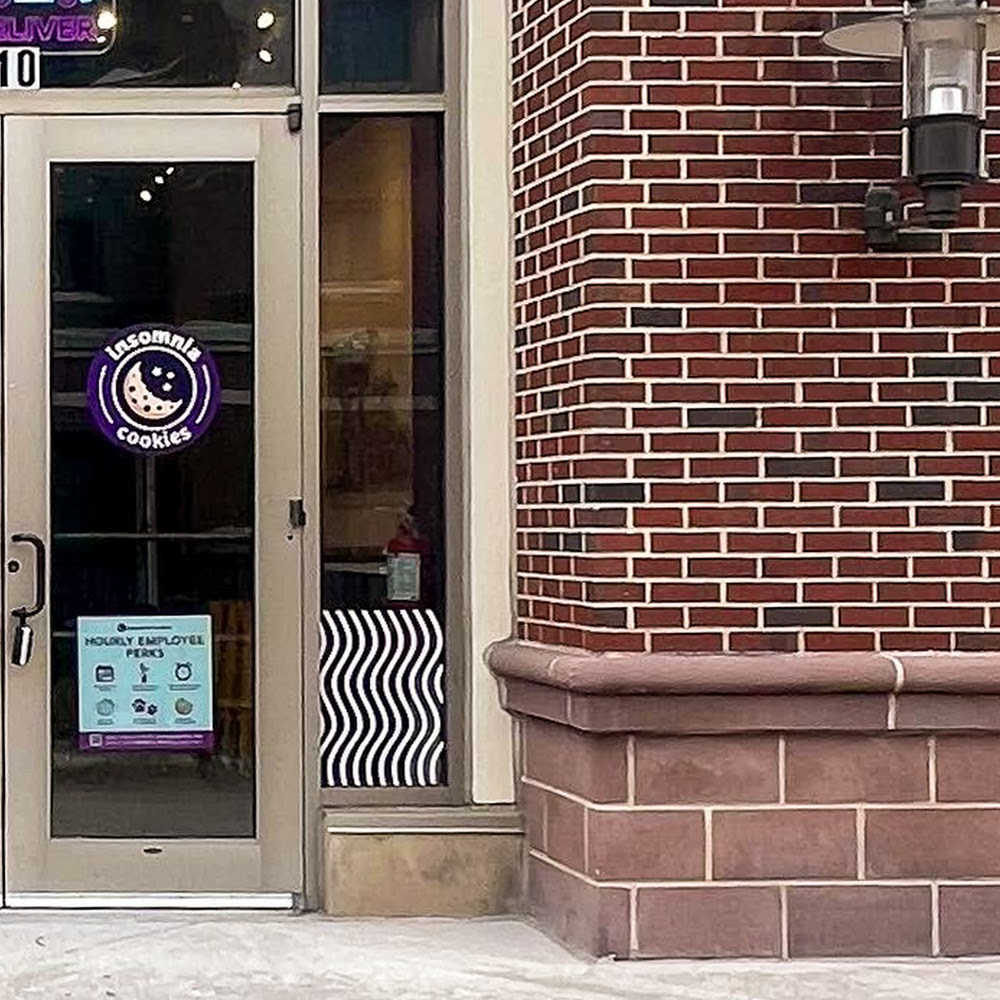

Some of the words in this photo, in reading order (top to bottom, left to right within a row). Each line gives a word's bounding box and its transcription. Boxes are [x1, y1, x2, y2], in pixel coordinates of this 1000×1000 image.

[116, 426, 192, 450] cookies
[137, 635, 205, 647] EMPLOYEE
[126, 648, 164, 658] PERKS
